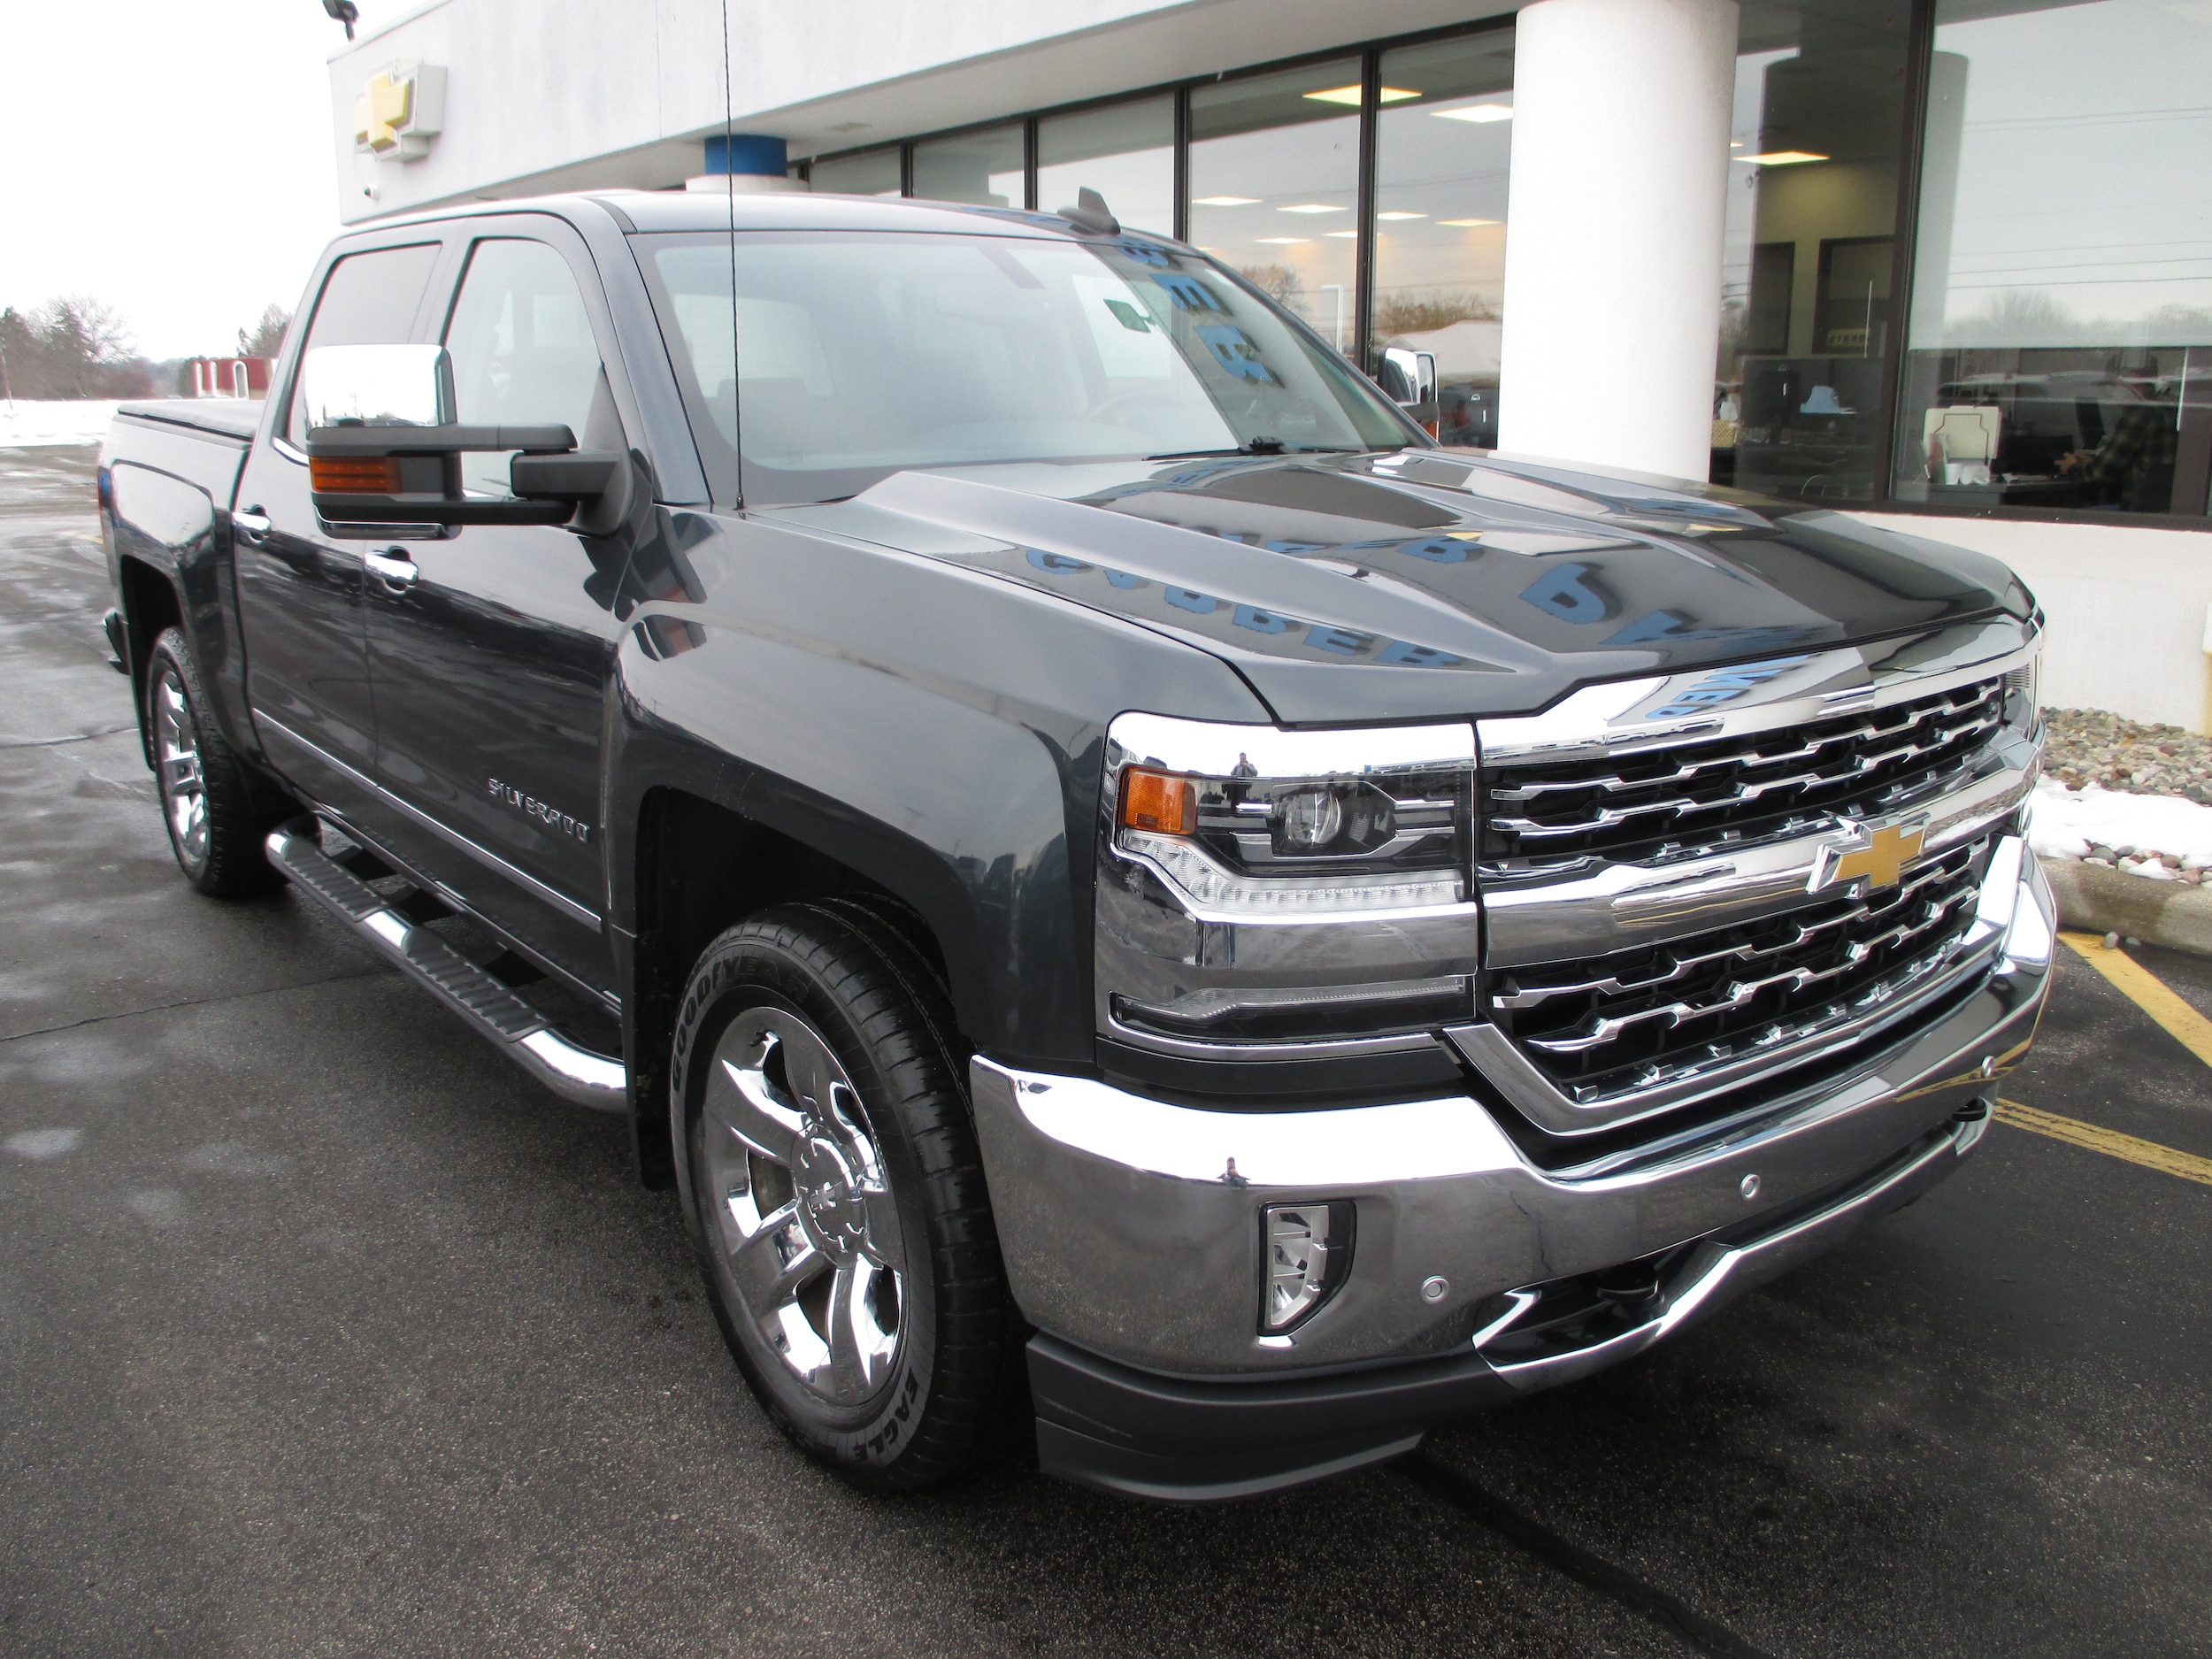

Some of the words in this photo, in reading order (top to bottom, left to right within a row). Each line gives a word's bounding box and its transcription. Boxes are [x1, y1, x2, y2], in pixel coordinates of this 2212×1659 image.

[488, 777, 591, 843] SILVERADO
[672, 955, 811, 1094] GOODYEAR
[854, 1366, 919, 1460] EAGLE
